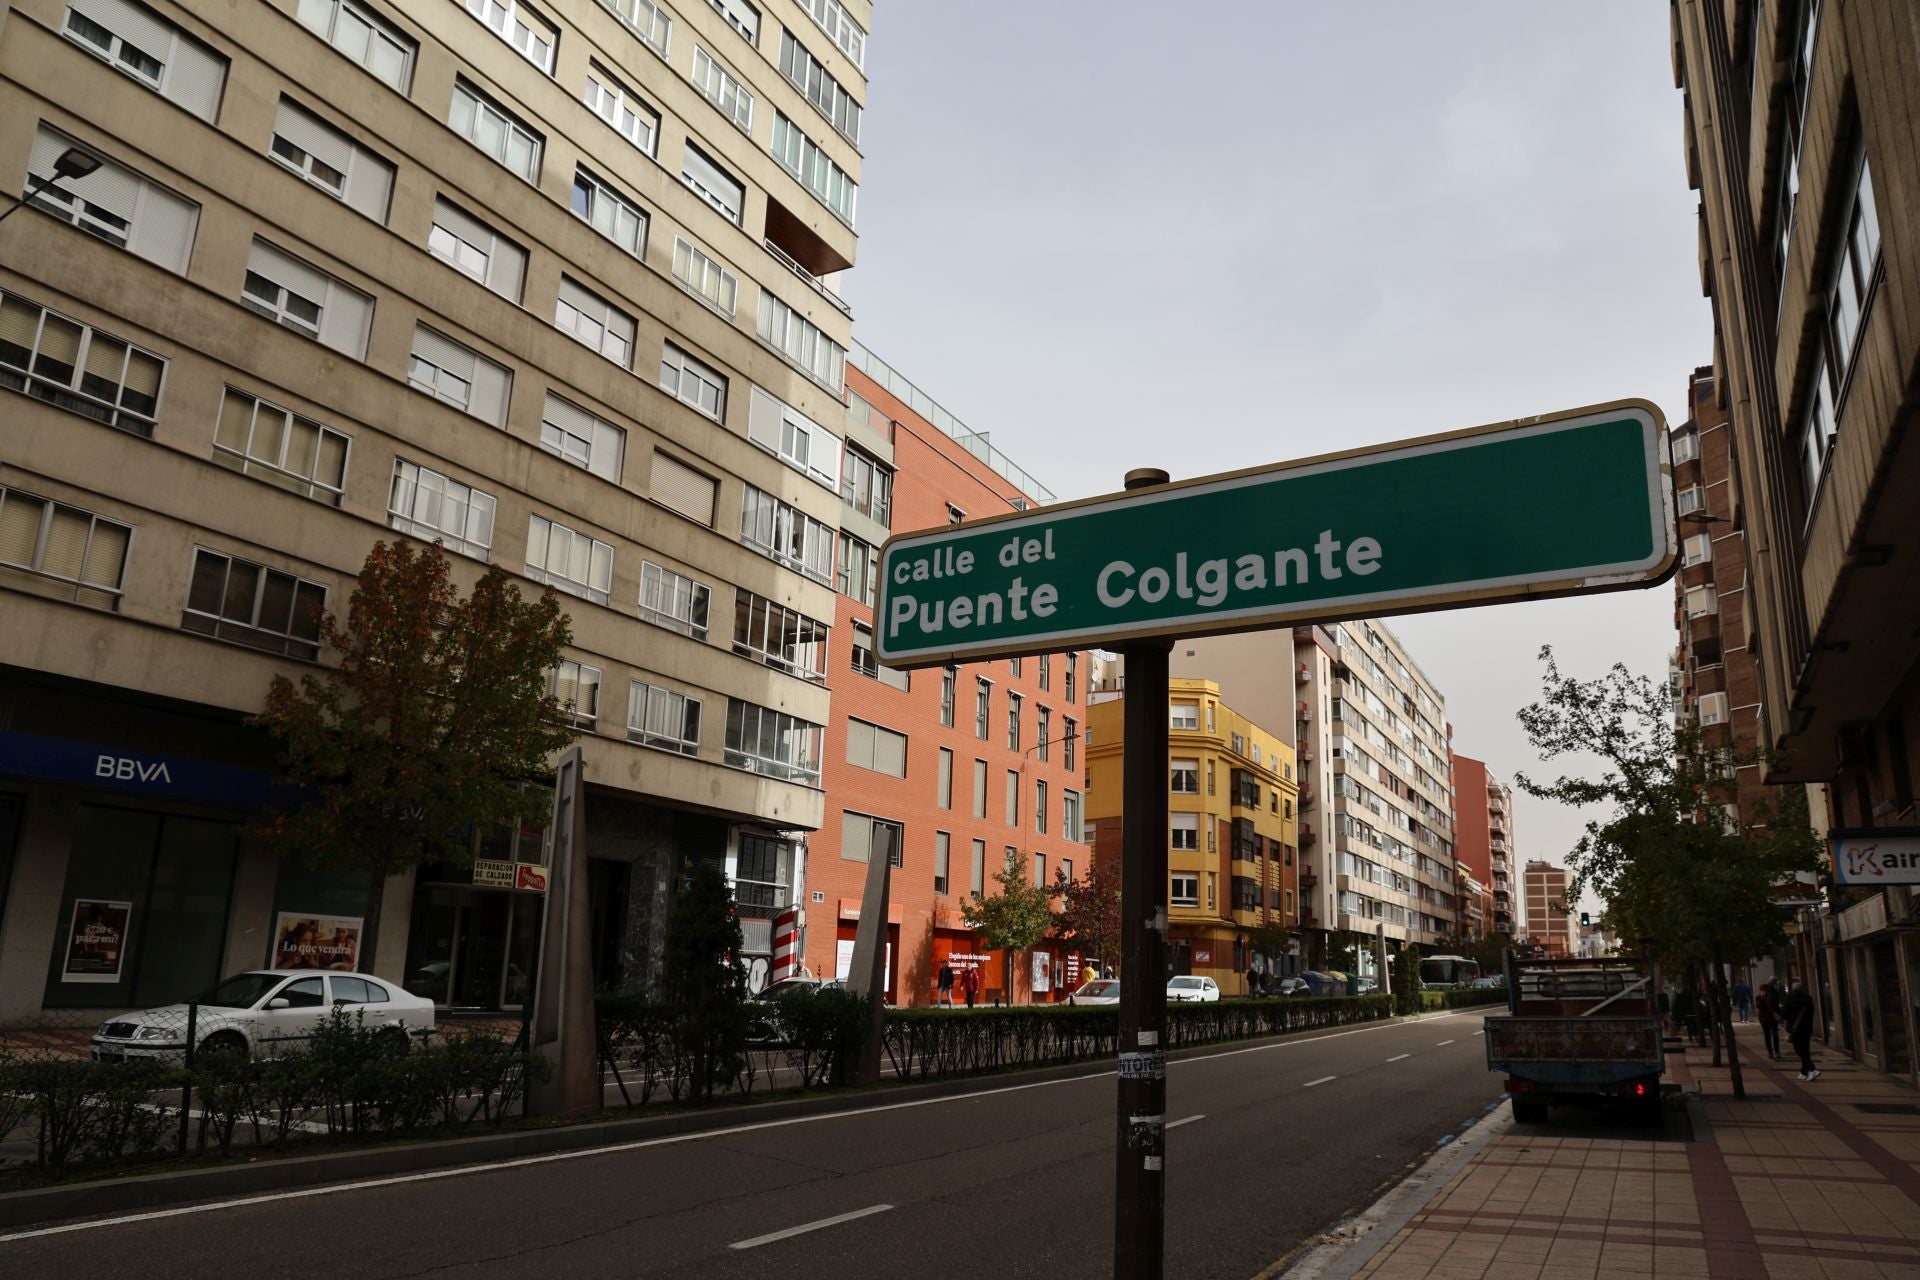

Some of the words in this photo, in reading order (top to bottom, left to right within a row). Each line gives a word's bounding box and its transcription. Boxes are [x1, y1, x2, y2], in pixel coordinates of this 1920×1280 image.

[894, 546, 975, 585] calle
[999, 528, 1056, 568] del
[889, 576, 1059, 638] Puente
[1096, 529, 1383, 608] Colgante
[96, 755, 171, 783] BBVA
[475, 870, 482, 878] DE
[486, 871, 513, 880] CALZADO
[283, 940, 298, 952] Lo
[298, 944, 318, 956] que
